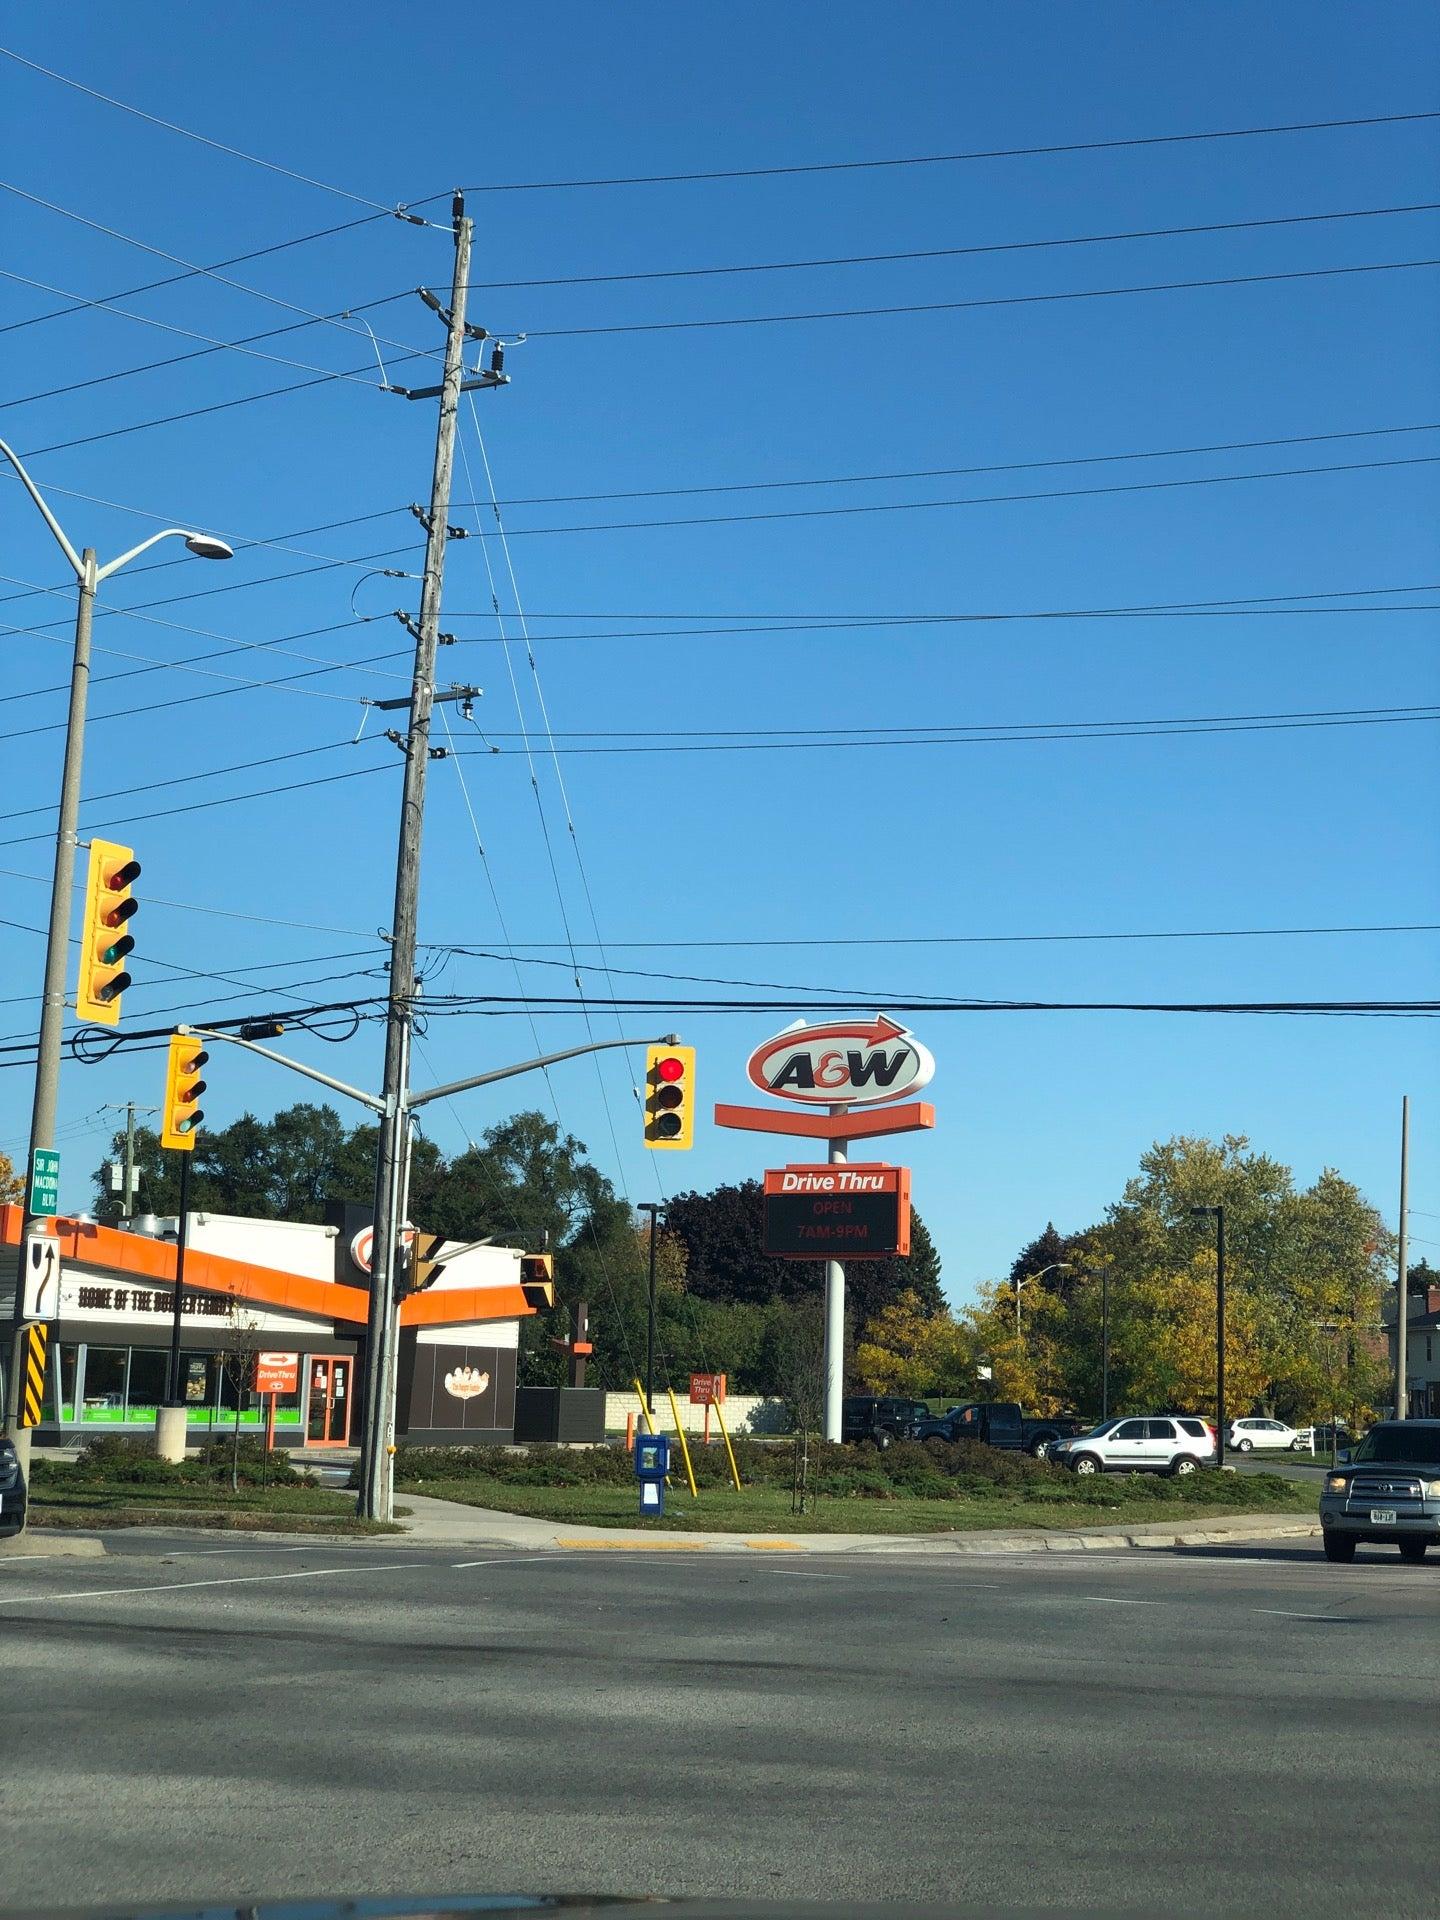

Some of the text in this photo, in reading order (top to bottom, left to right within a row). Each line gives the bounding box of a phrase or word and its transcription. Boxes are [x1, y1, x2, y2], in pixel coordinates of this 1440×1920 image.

[767, 1050, 910, 1088] A&W
[36, 1158, 45, 1171] SIR
[782, 1172, 884, 1190] Drive Thru
[42, 1193, 55, 1207] BLVD
[813, 1202, 852, 1215] OPEN
[798, 1225, 868, 1239] 7AM-9PM
[79, 1287, 113, 1309] HOME
[114, 1289, 129, 1310] OF
[131, 1290, 153, 1312] THE
[154, 1292, 196, 1314] BURER
